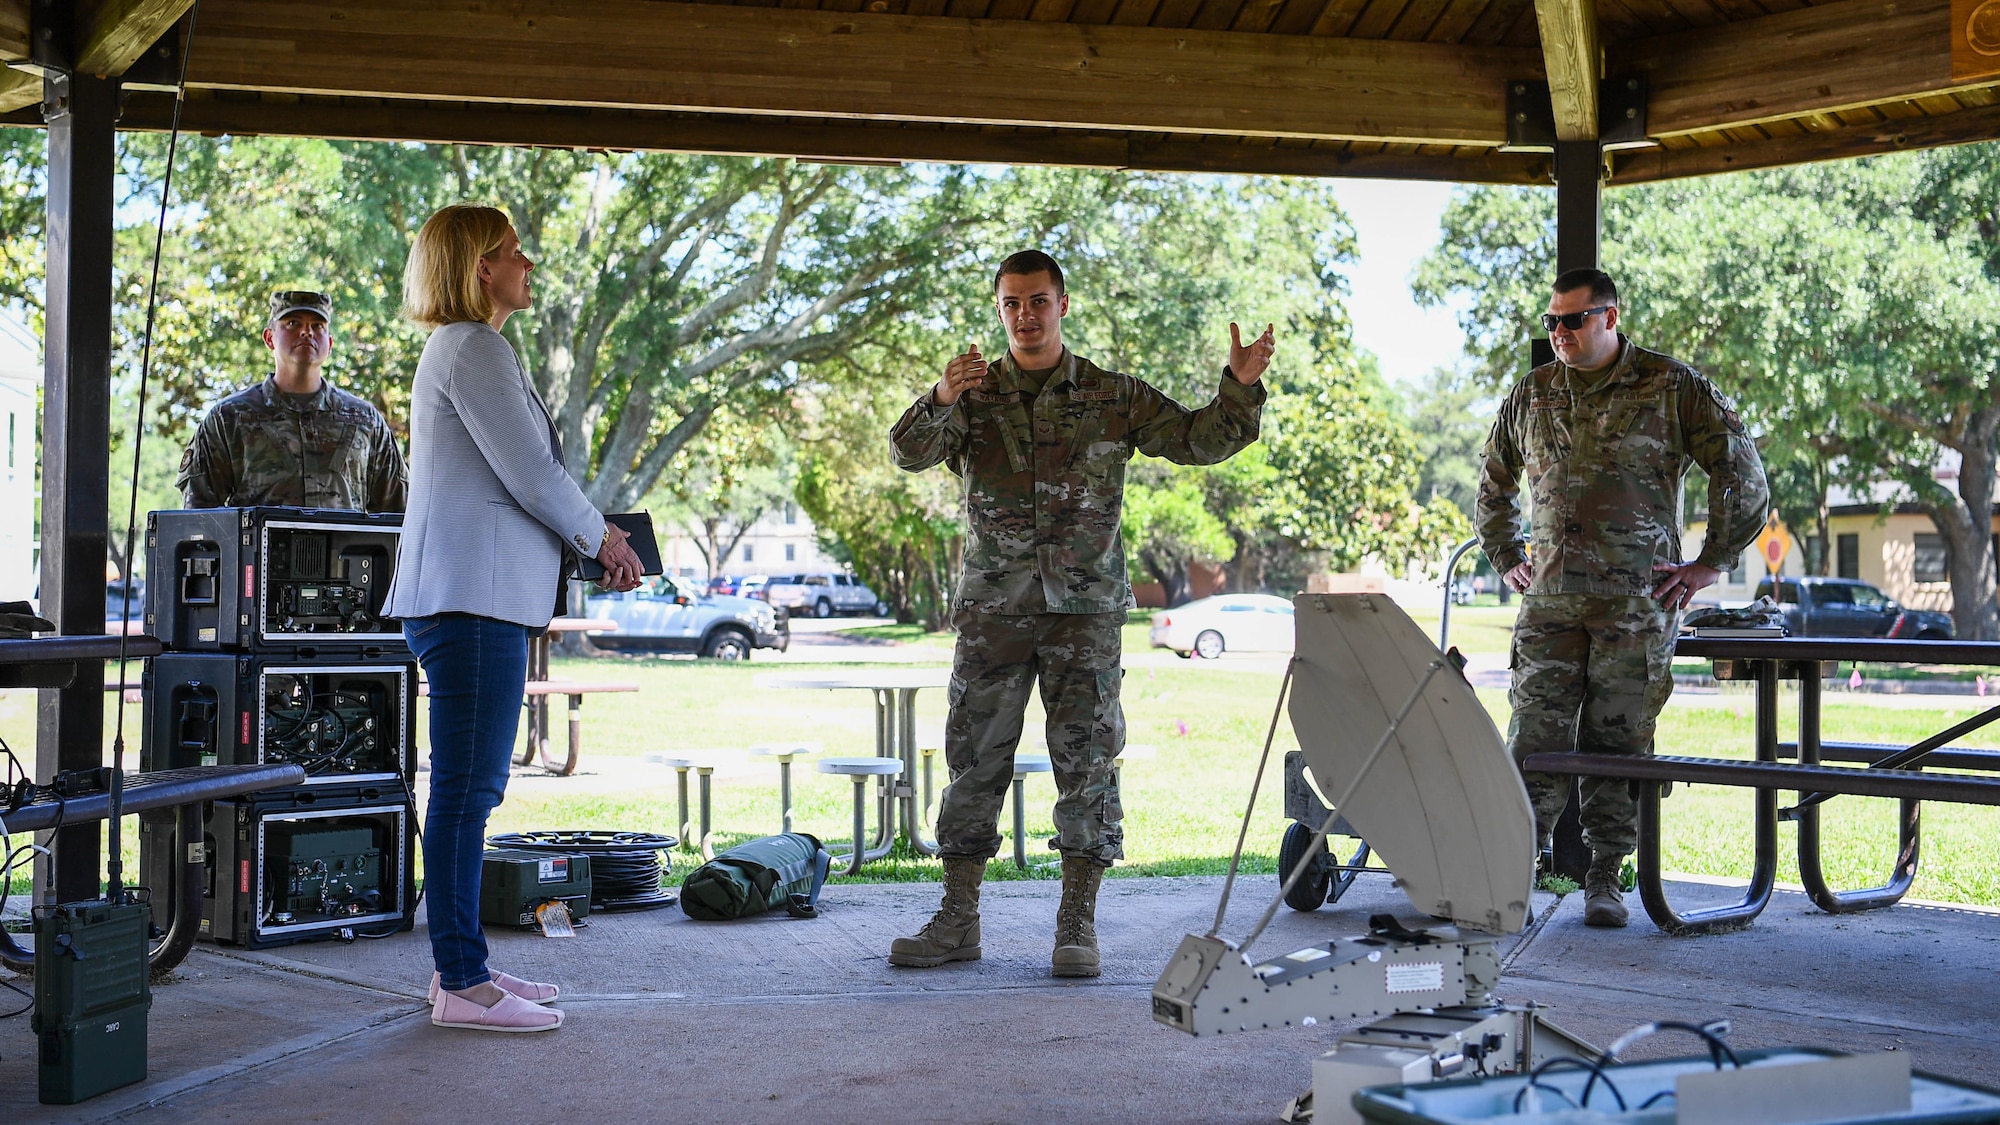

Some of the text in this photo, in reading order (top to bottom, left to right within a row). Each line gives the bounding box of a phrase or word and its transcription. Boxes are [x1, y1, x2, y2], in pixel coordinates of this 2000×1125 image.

[1083, 391, 1094, 400] AIR
[1095, 389, 1117, 400] FORCE
[105, 1021, 120, 1033] CARC
